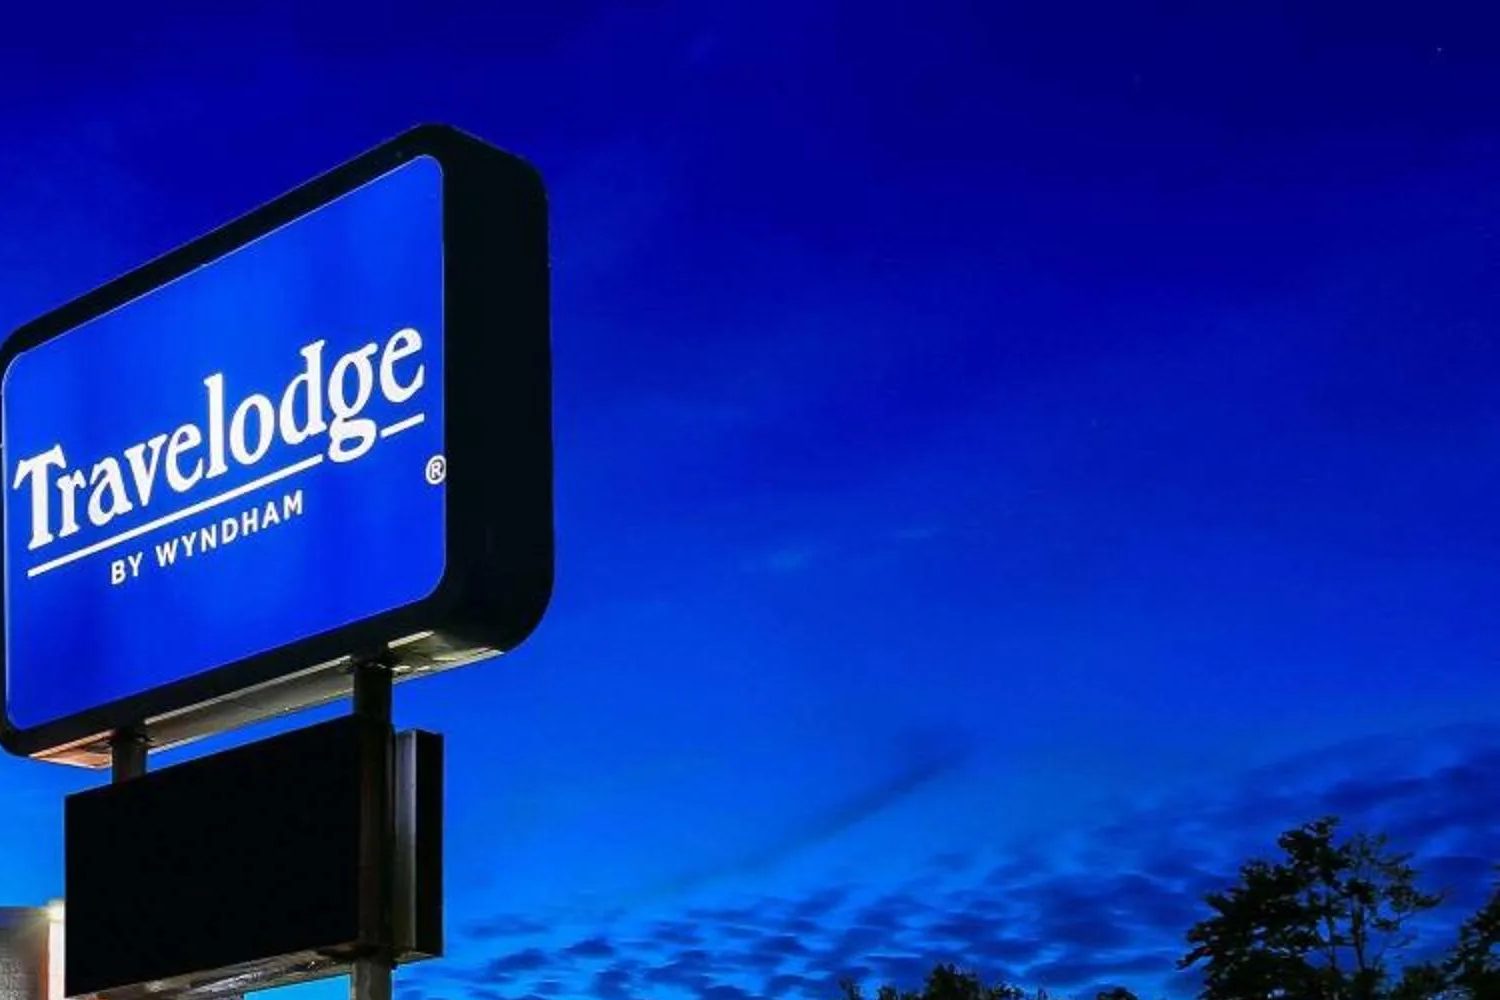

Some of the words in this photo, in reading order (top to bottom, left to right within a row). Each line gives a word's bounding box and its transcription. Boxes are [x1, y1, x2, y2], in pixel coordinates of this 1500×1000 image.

[12, 327, 425, 550] Travelodge
[110, 551, 144, 586] BY
[155, 489, 304, 568] WYNDHAM
